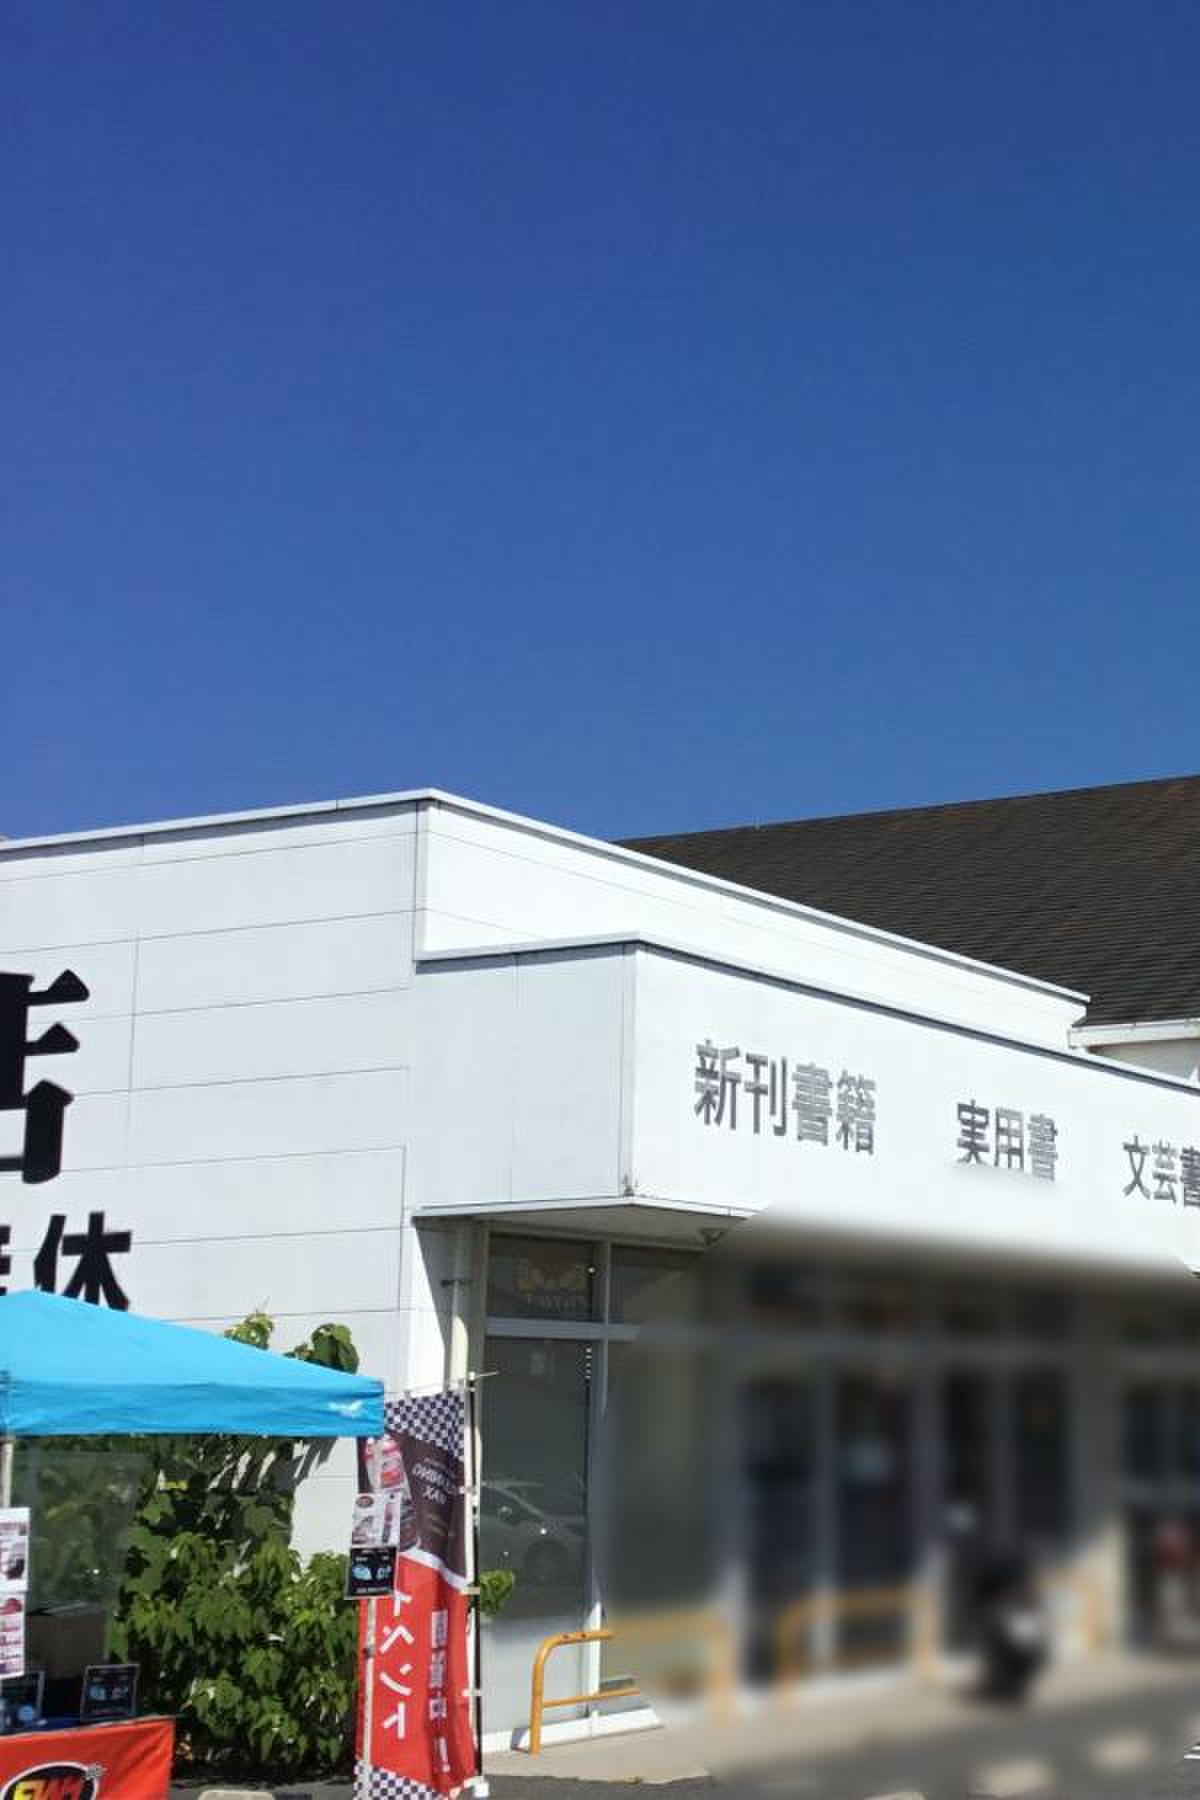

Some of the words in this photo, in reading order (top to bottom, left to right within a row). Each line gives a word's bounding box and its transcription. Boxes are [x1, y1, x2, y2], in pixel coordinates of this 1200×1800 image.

[694, 1039, 877, 1156] 新刊書籍
[956, 1099, 1059, 1183] 実用書
